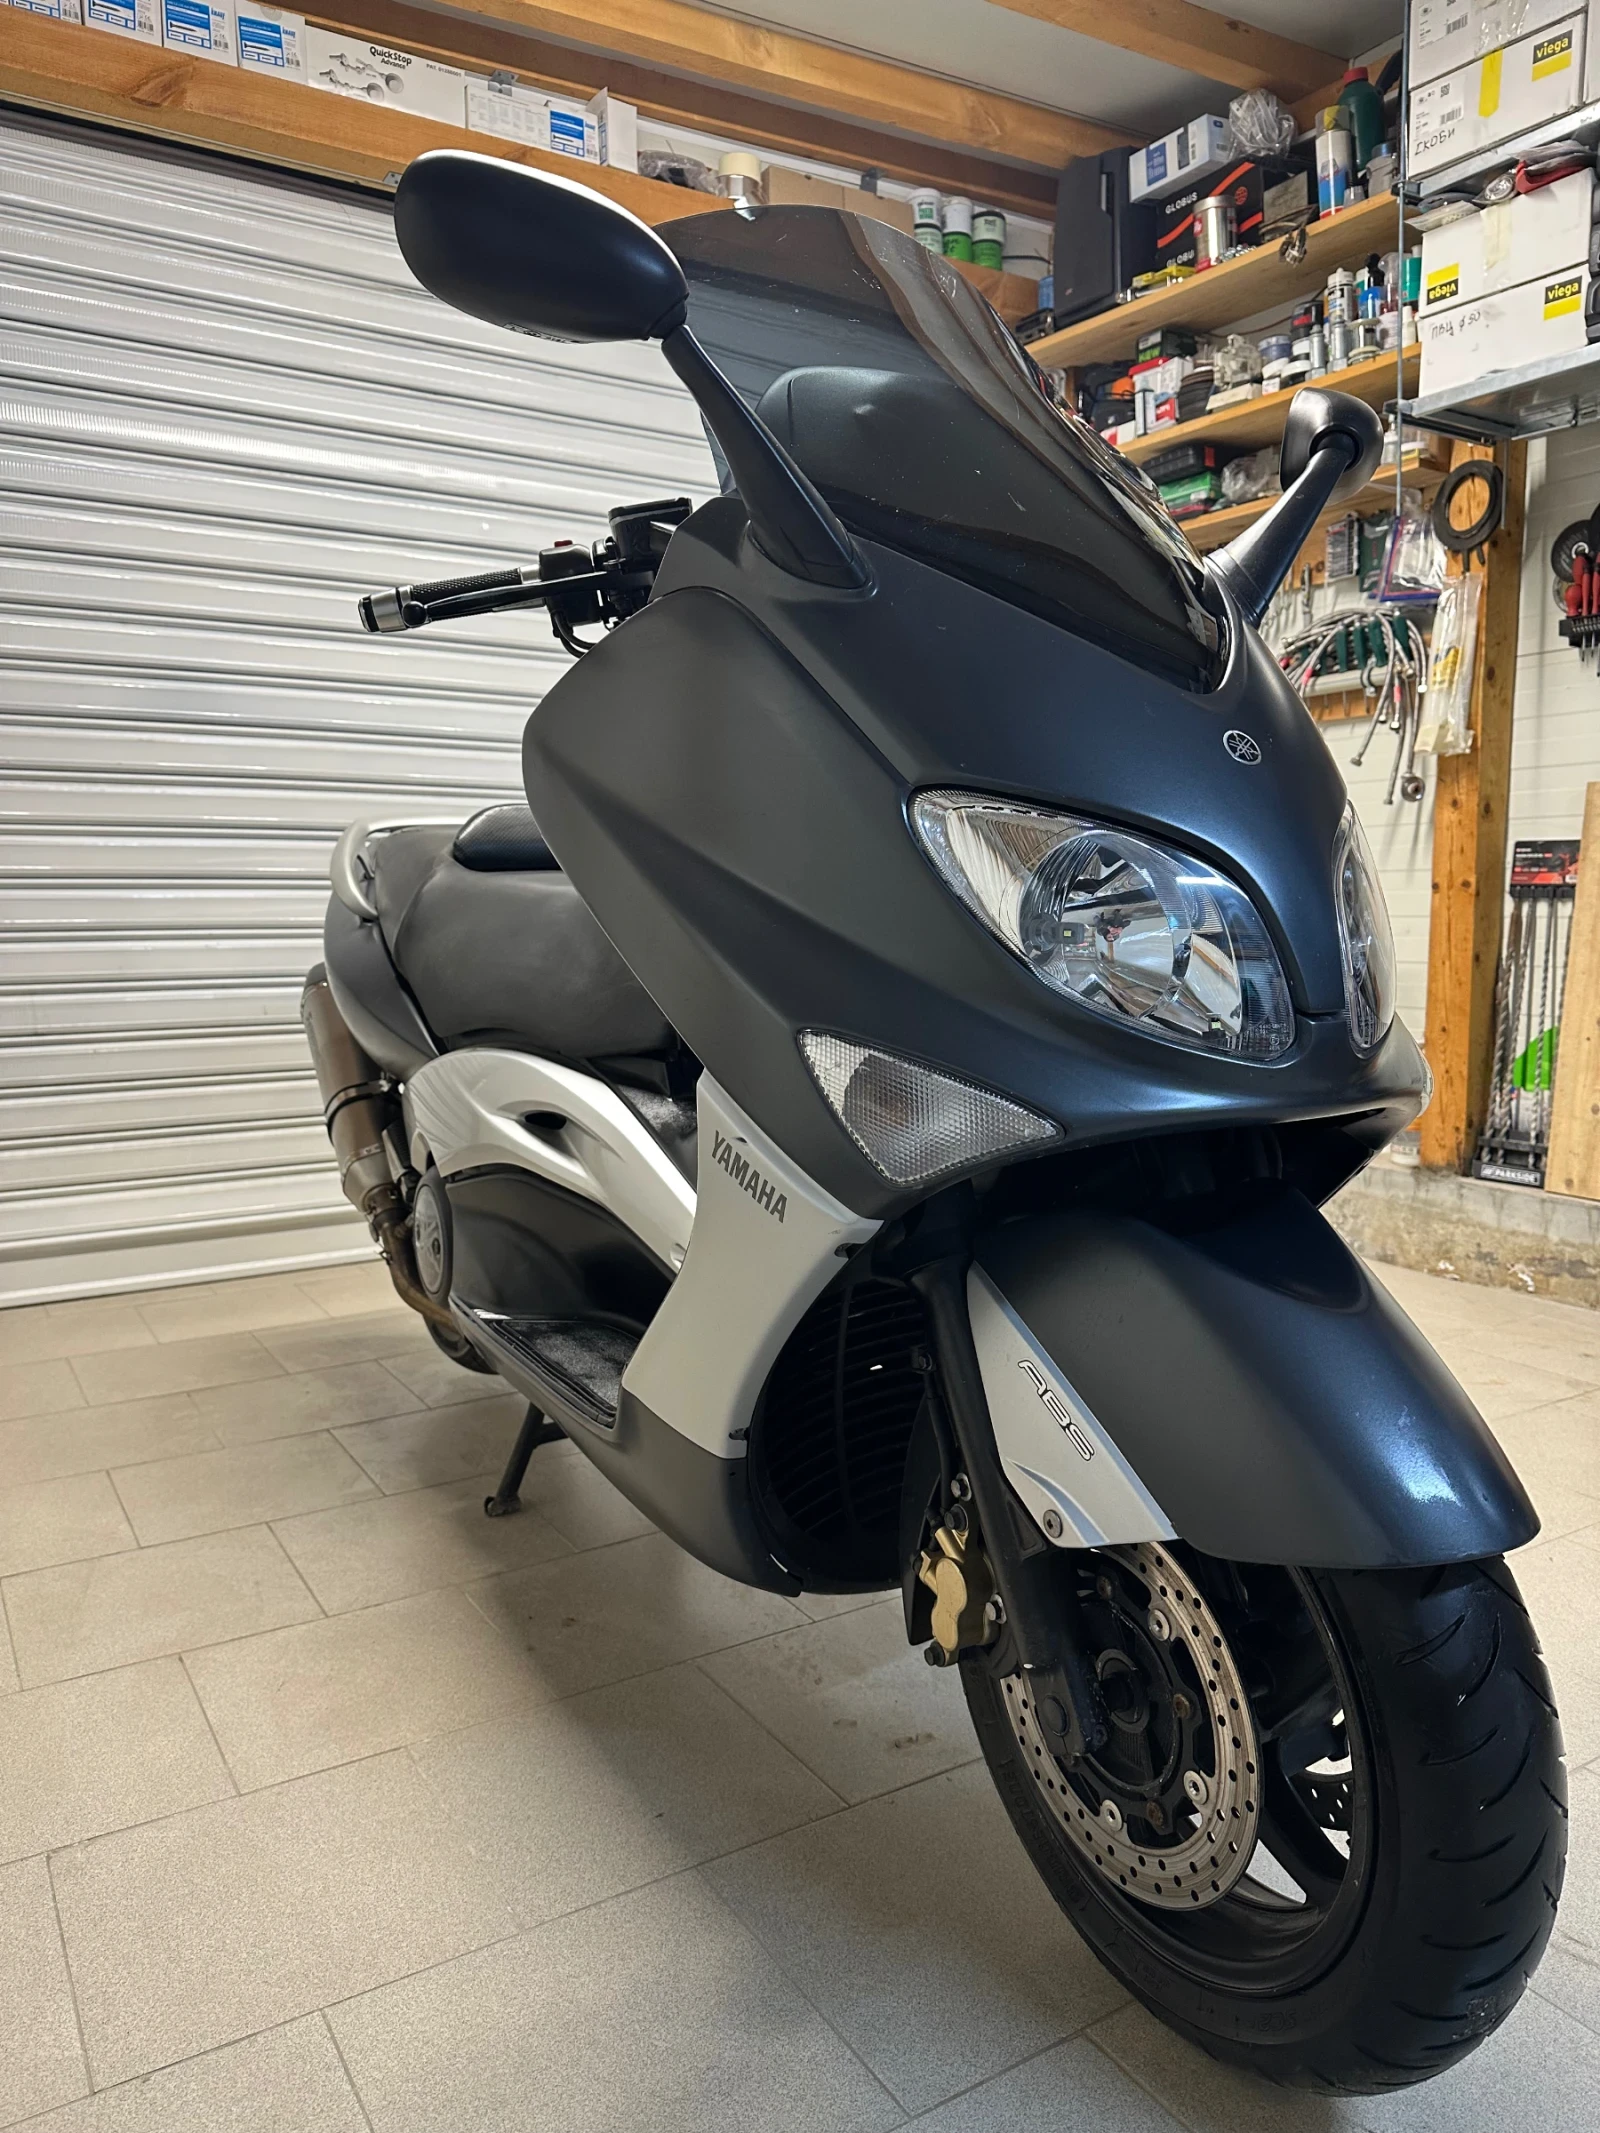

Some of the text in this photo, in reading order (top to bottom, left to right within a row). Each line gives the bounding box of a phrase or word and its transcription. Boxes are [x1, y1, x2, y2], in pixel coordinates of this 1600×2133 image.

[369, 46, 412, 66] QuickStop
[1536, 37, 1569, 58] viega
[380, 58, 406, 70] Advance
[1165, 191, 1198, 214] GLOBUS
[1166, 249, 1195, 268] GLOBU
[1428, 281, 1456, 300] viega
[1547, 282, 1579, 300] viega
[711, 1129, 788, 1224] YAMAHA
[1017, 1359, 1096, 1461] ABS
